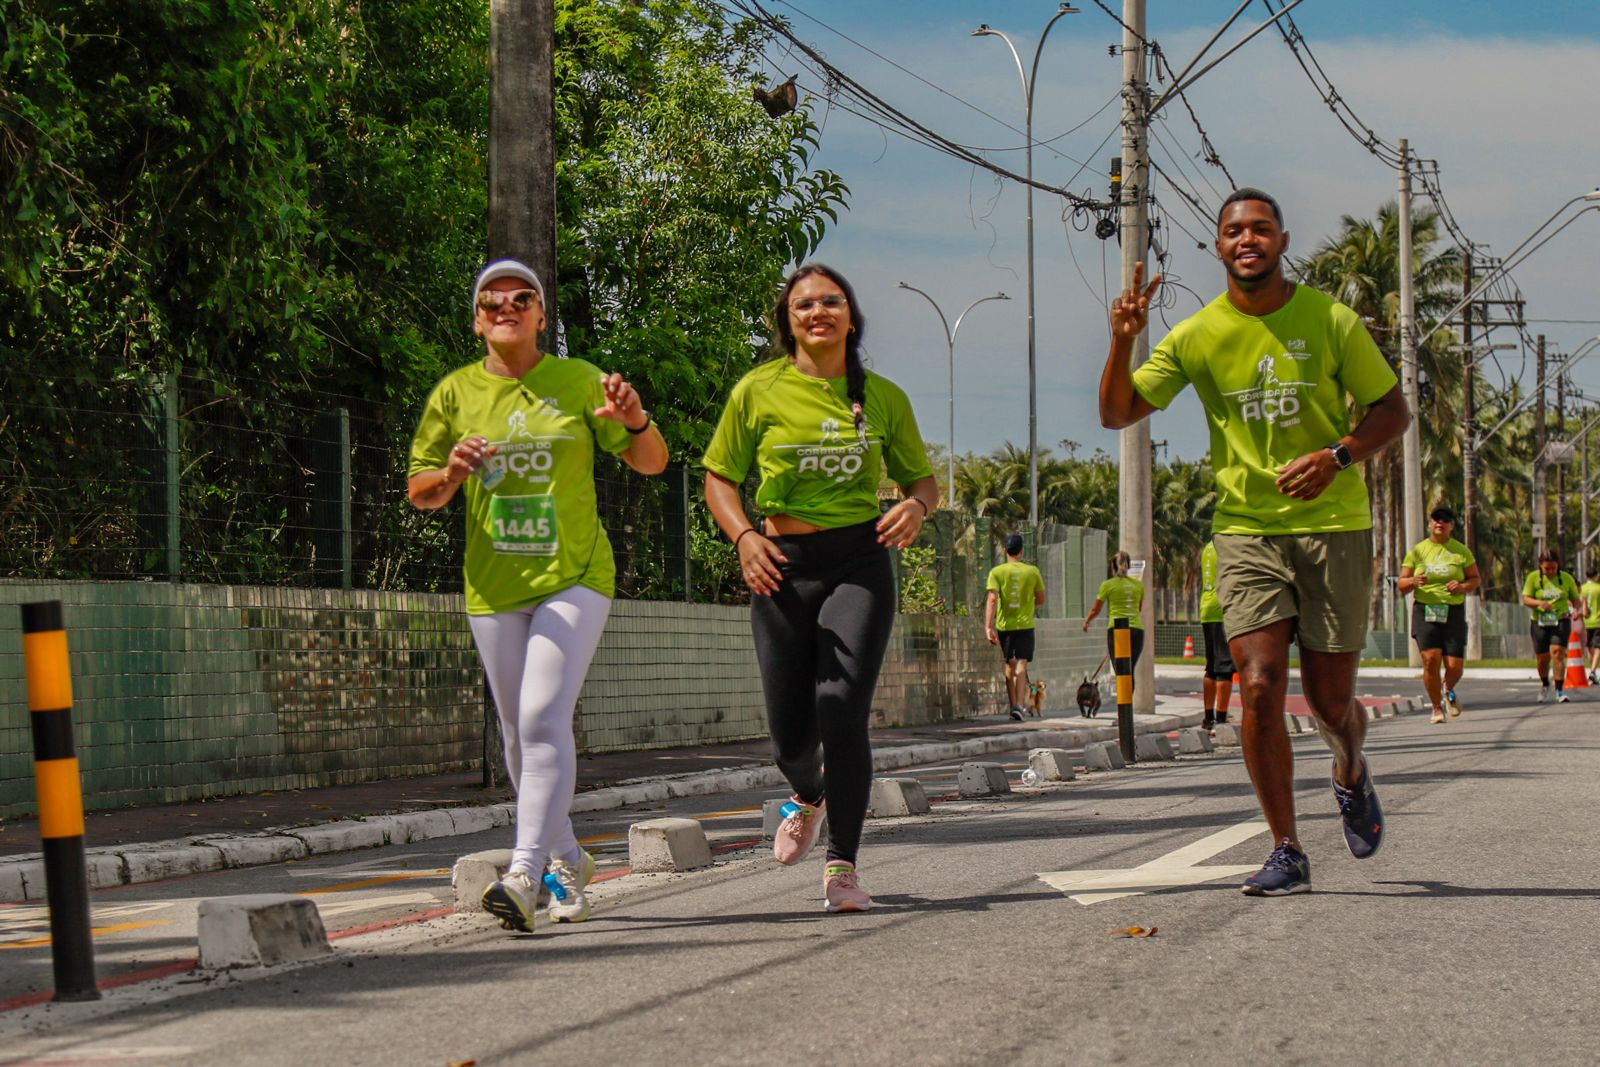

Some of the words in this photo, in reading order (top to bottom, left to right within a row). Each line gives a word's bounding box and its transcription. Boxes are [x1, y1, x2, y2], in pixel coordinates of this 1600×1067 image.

[1238, 389, 1281, 402] CORRIDA
[1282, 387, 1297, 396] DO
[1241, 396, 1300, 424] AÇO
[536, 441, 552, 450] DO
[848, 446, 863, 455] DO
[798, 454, 863, 478] AÇO
[495, 517, 551, 538] 1445
